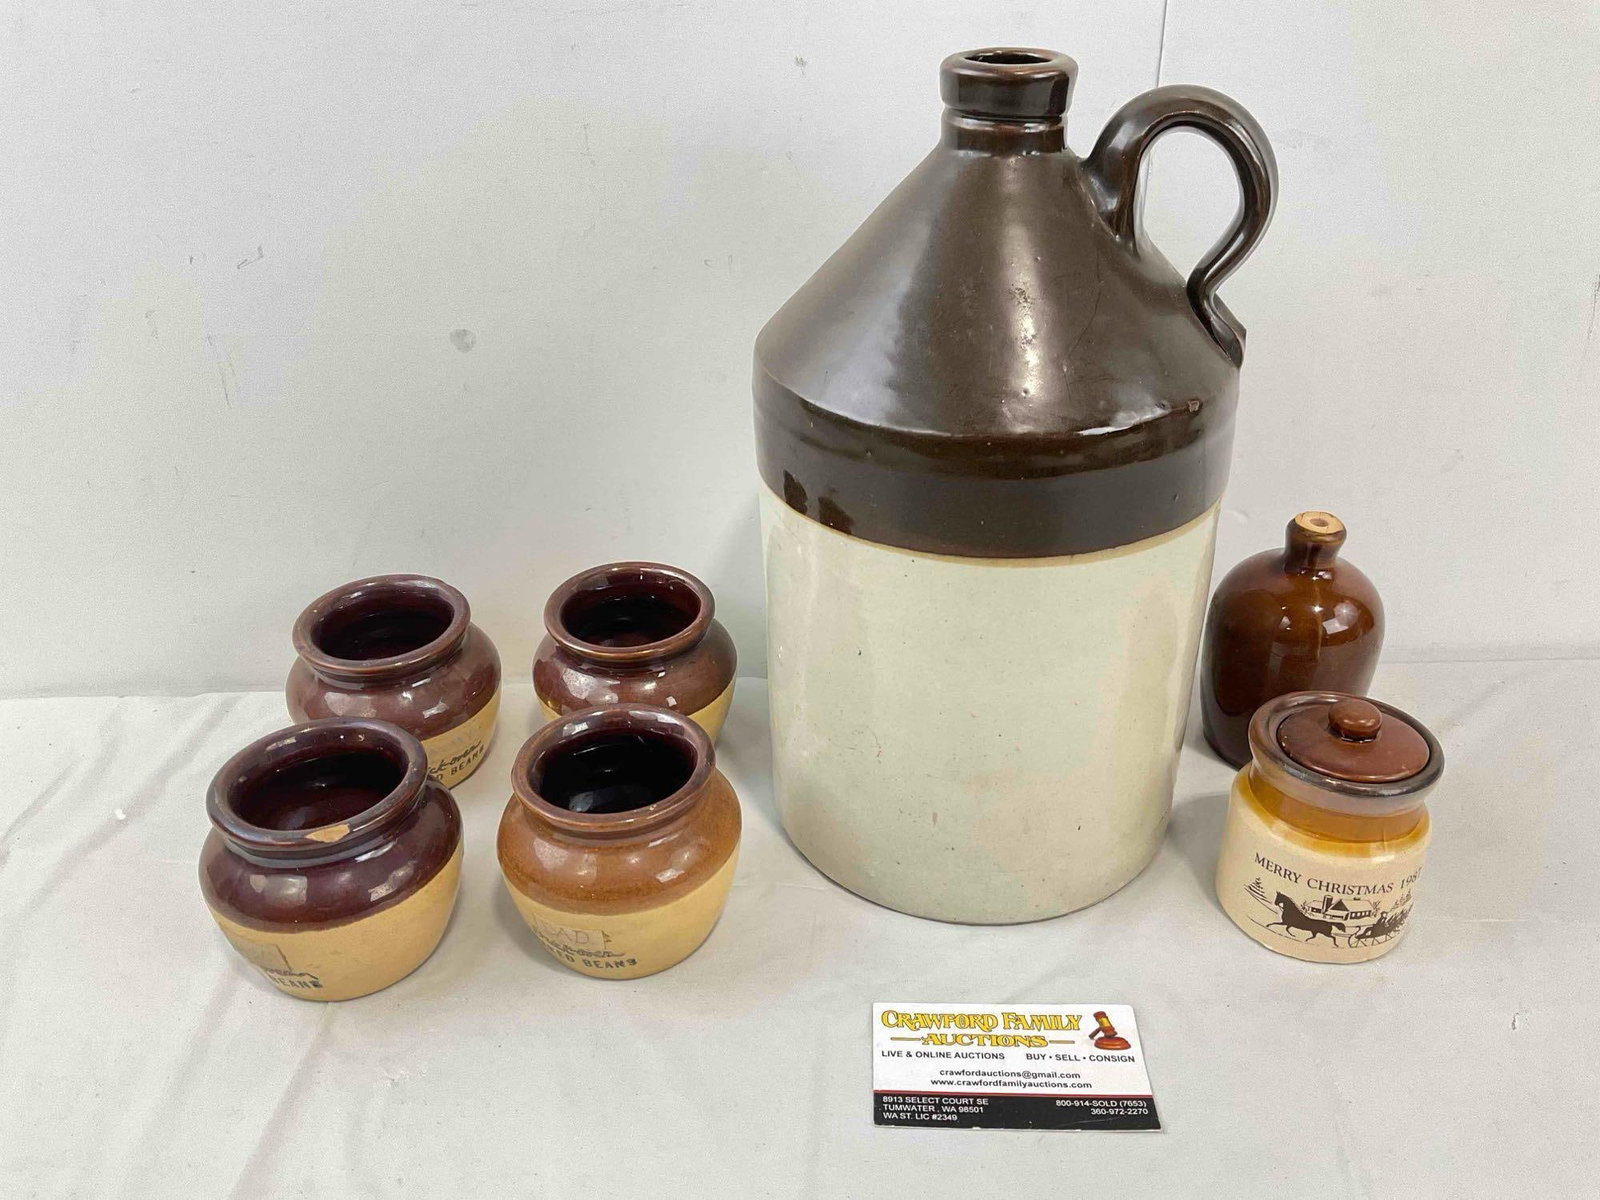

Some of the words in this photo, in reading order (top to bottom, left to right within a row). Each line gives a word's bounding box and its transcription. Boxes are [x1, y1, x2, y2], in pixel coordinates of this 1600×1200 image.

[1255, 852, 1302, 883] MERRY
[1307, 878, 1393, 896] CHRISTMAS
[582, 958, 638, 969] BEANS
[881, 1010, 998, 1032] CRAWFORD
[1002, 1012, 1082, 1031] FAMILY
[922, 1034, 1048, 1048] AUCTIONS
[954, 1052, 1005, 1060] AUCTIONS
[940, 1070, 1080, 1079] crawfordauctions@gmail.com
[931, 1079, 1092, 1088] www.crawfordfamilyauctions.com
